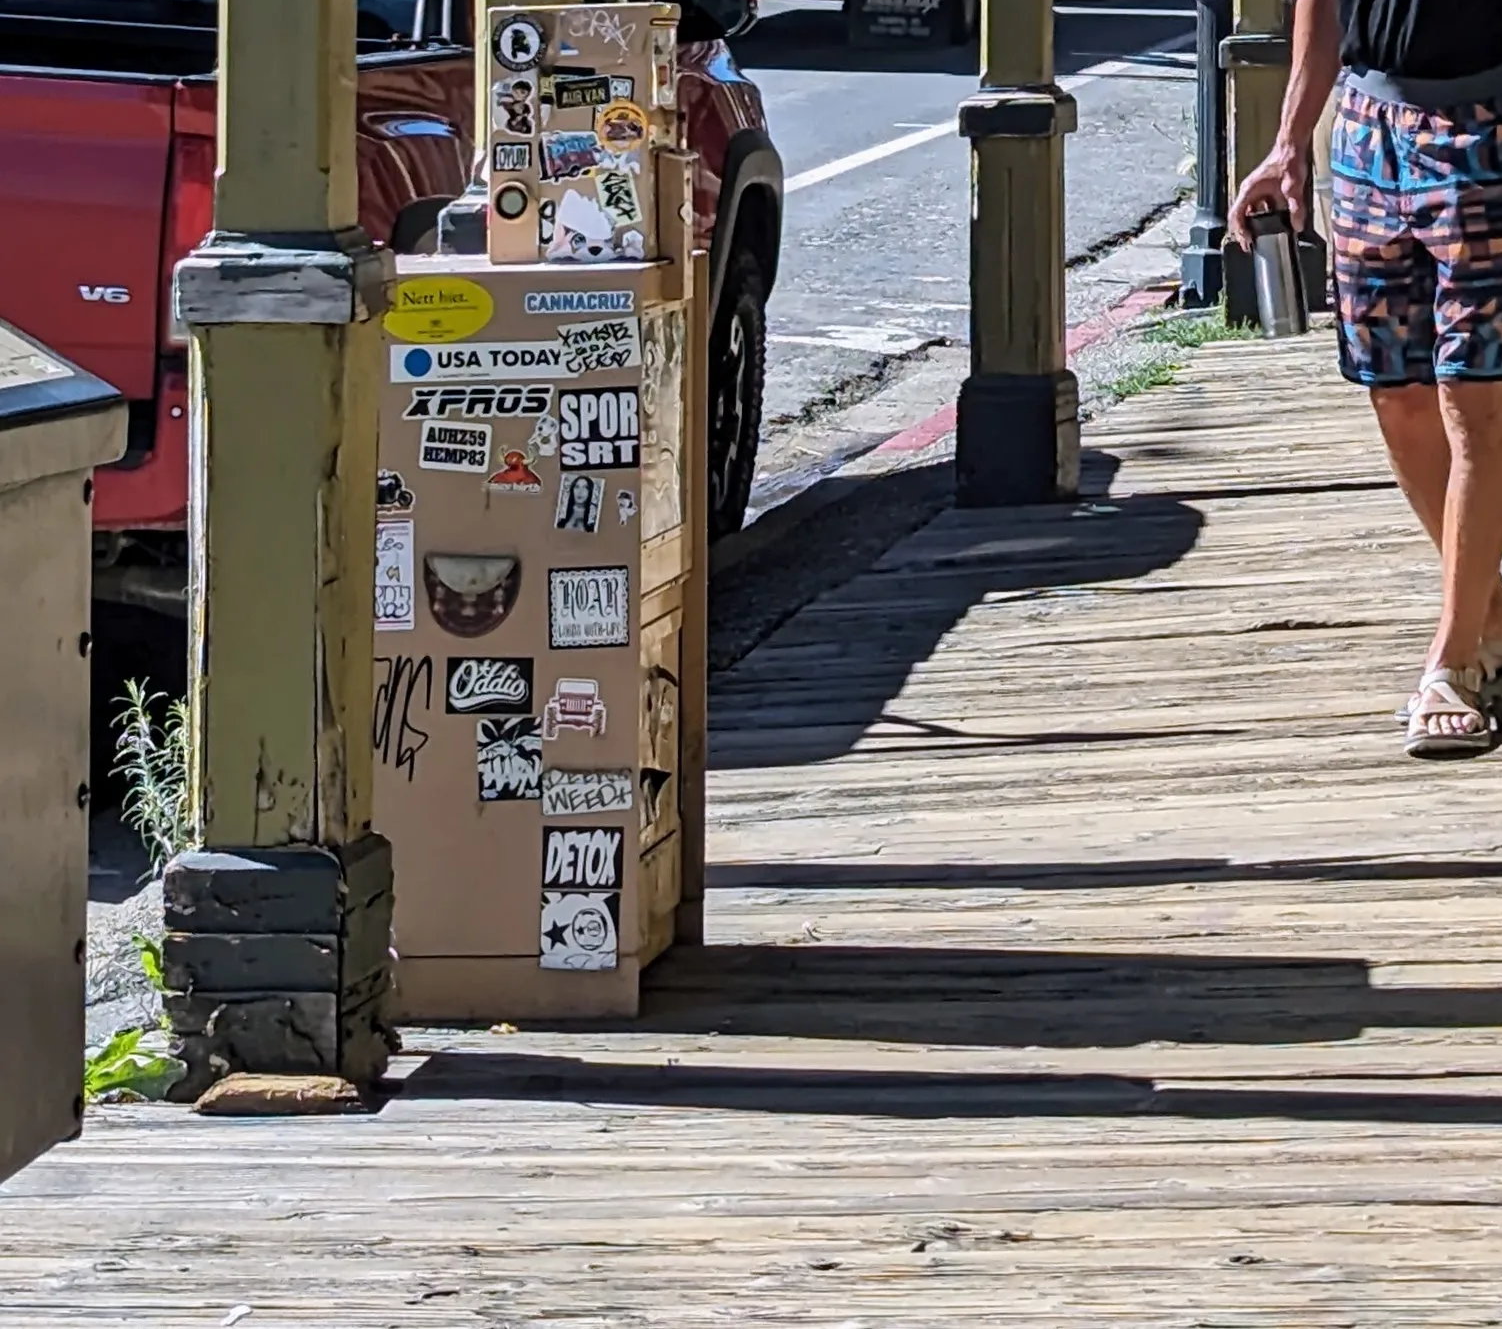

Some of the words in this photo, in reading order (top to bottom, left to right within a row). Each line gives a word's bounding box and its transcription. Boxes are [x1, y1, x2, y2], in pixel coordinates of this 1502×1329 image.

[78, 285, 131, 303] V6
[526, 292, 633, 312] CANNACRUZ
[437, 351, 482, 368] USA
[488, 348, 561, 367] TODAY
[561, 392, 639, 441] SPOR
[423, 445, 485, 467] HEMP83
[562, 440, 639, 466] SRT
[559, 577, 621, 620] ROAR
[544, 829, 621, 887] DETOX
